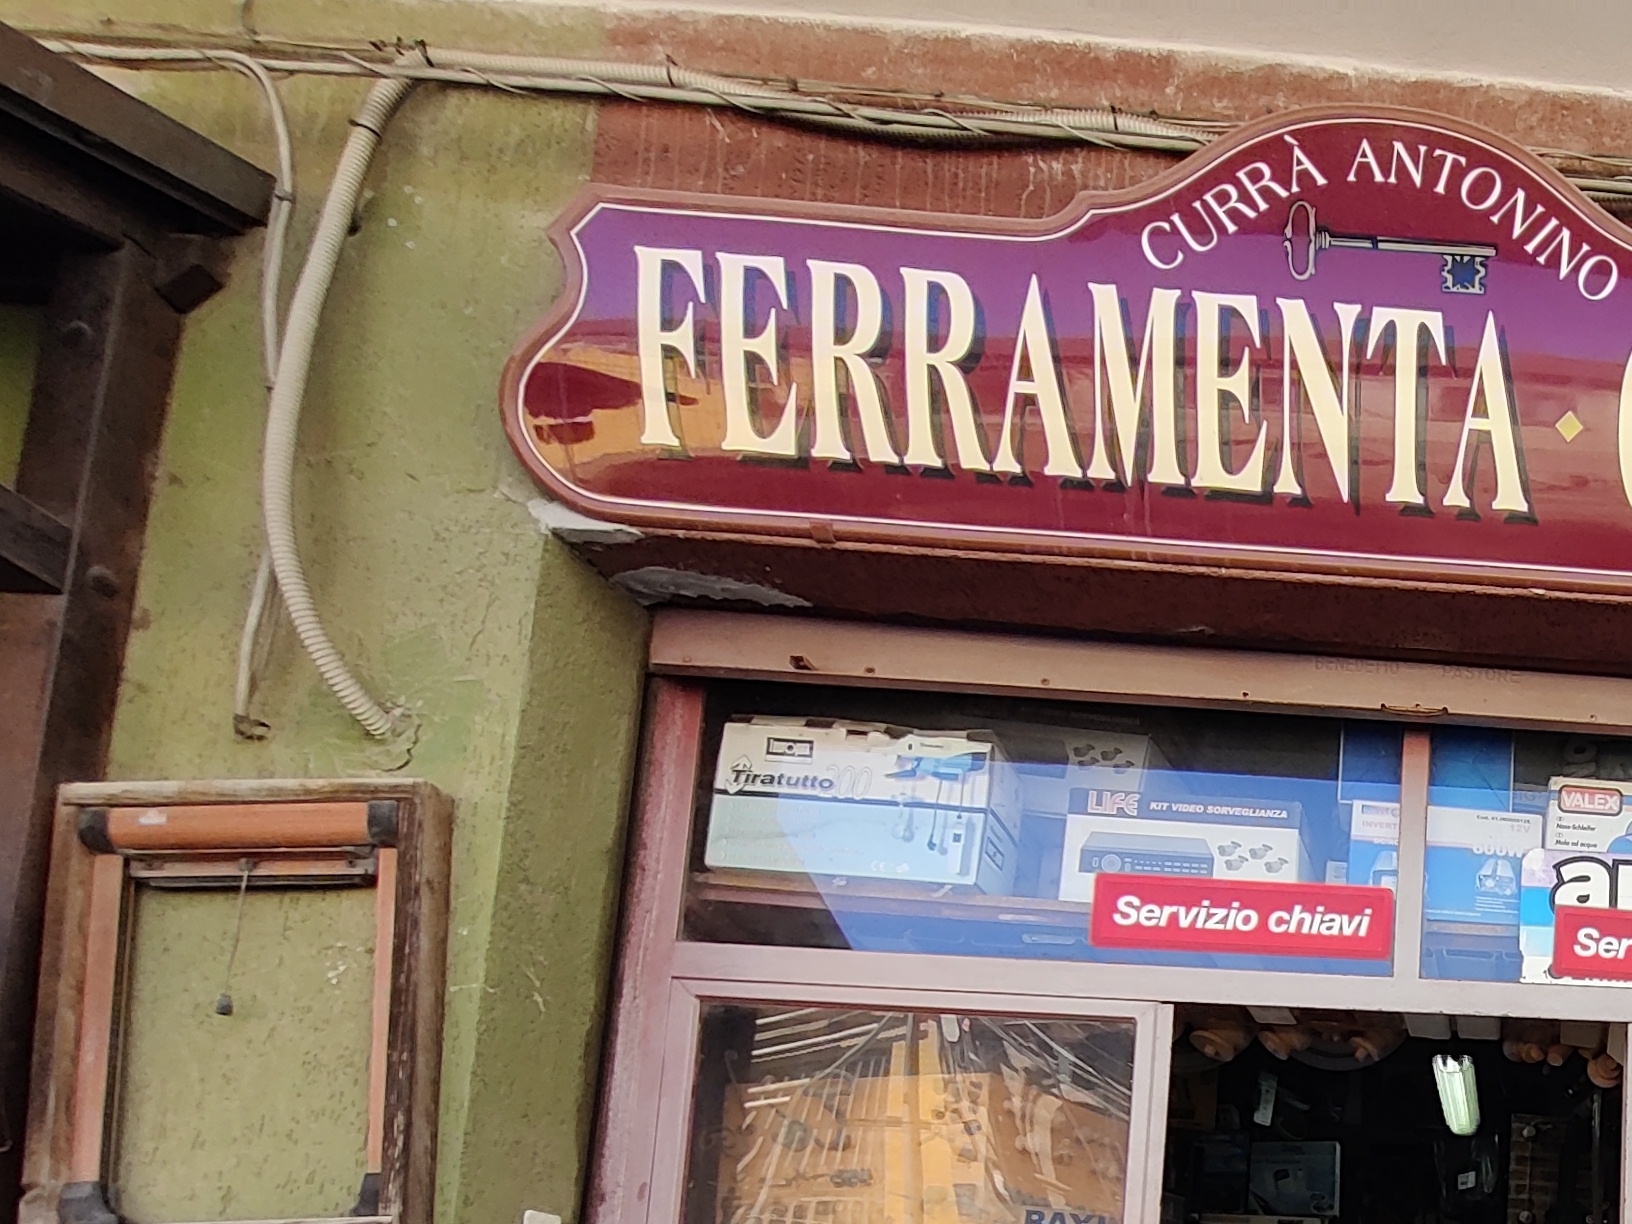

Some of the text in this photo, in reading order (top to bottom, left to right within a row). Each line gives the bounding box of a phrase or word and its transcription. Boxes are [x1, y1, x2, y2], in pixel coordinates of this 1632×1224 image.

[1141, 135, 1620, 302] CURRÀ ANTONINO
[633, 244, 1535, 518] FERRAMENTA
[1087, 790, 1288, 819] LIFE KIT VIDEO SORVEGLIANZA
[1560, 790, 1618, 810] VALEX
[1112, 894, 1373, 938] Servizio chiavi
